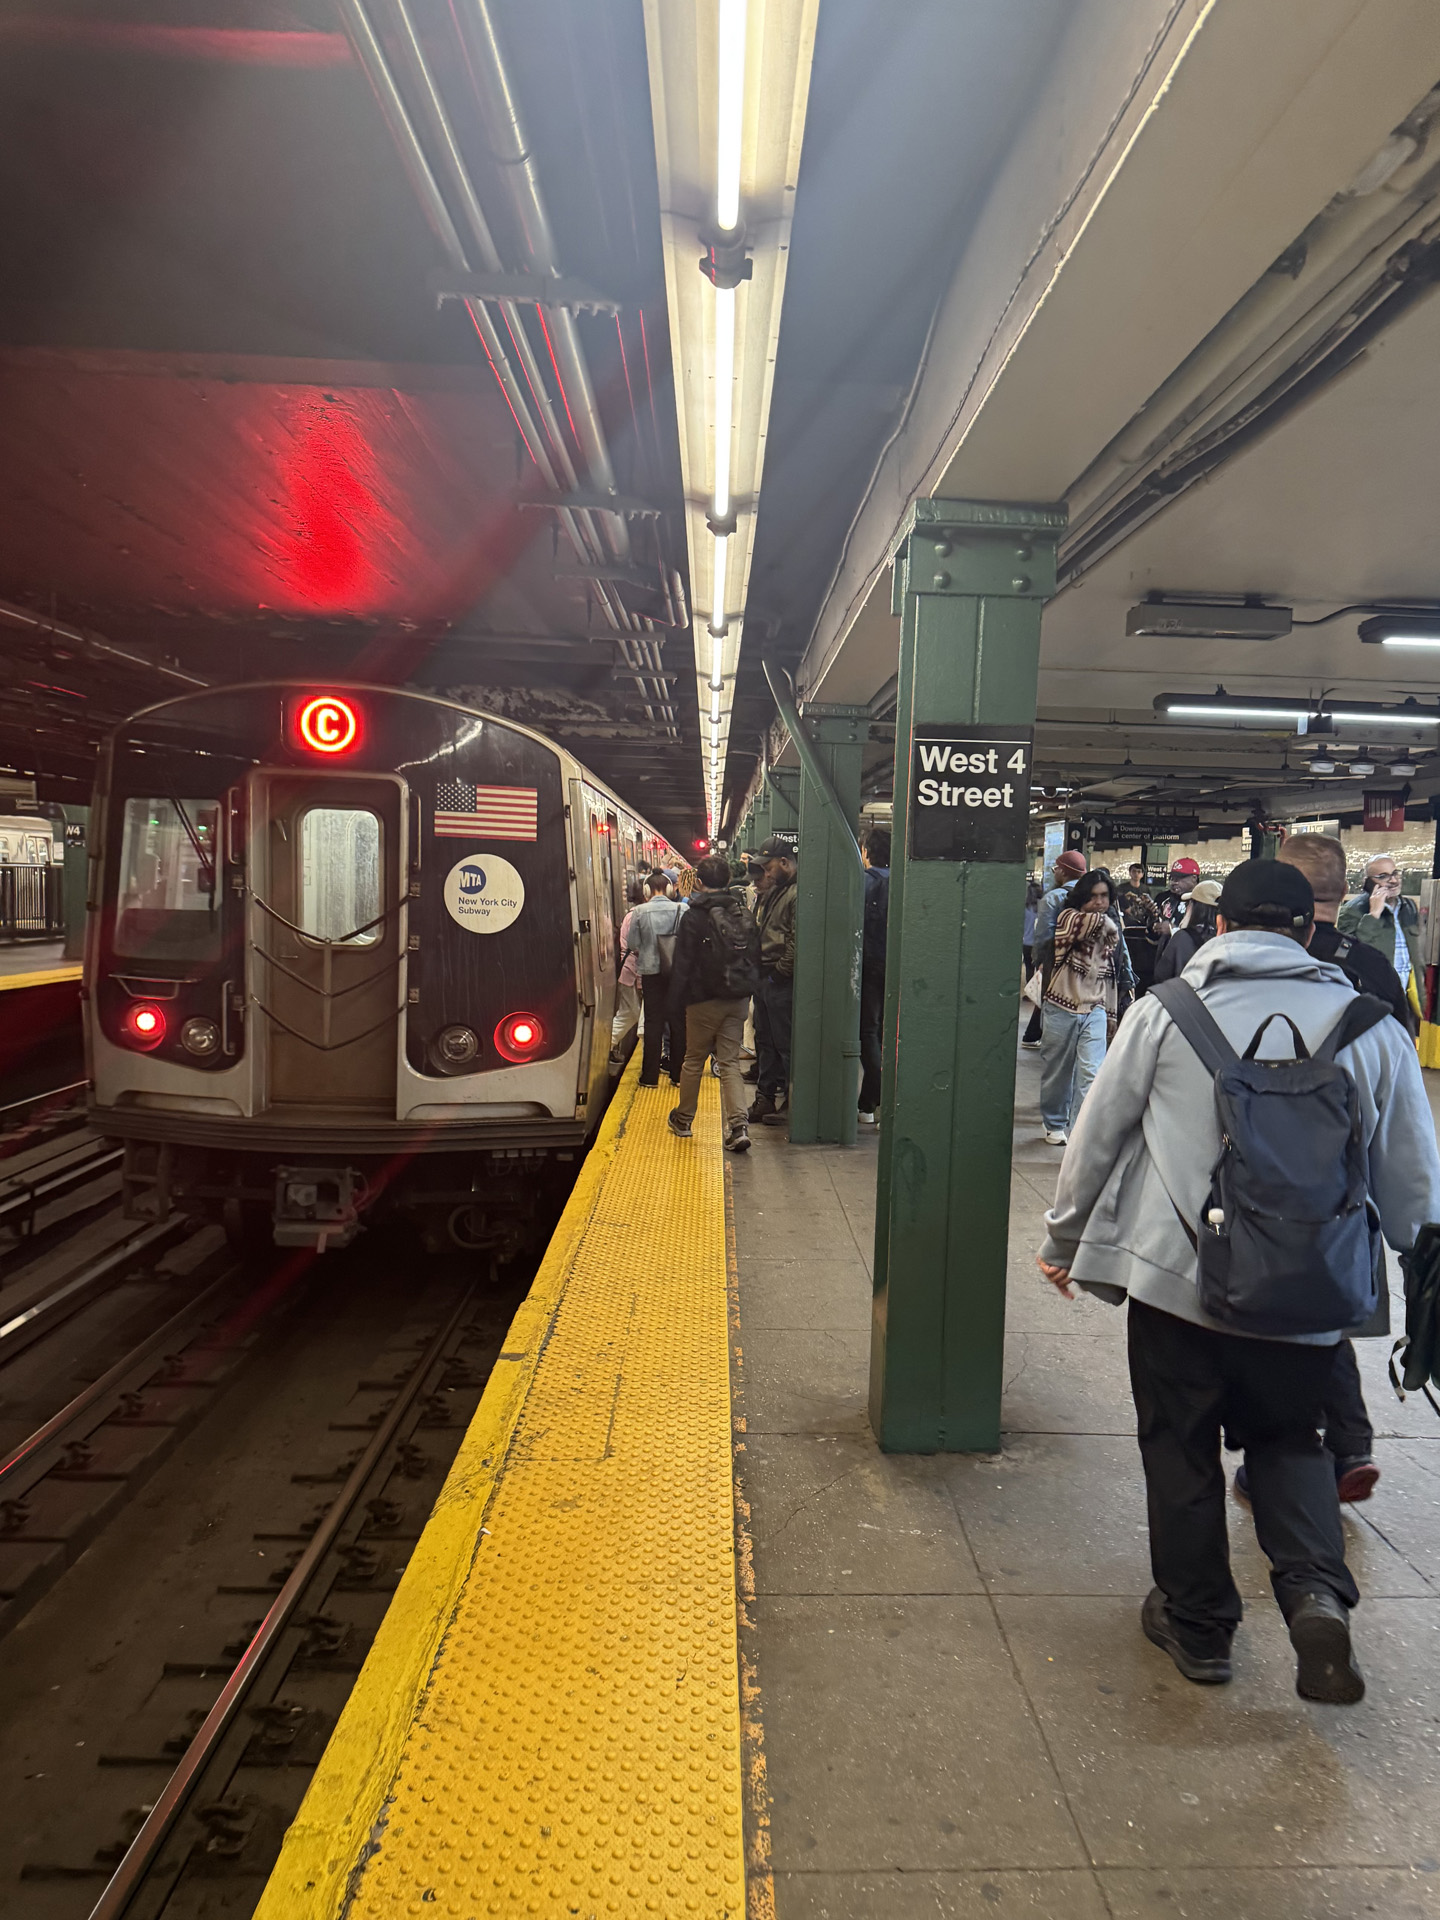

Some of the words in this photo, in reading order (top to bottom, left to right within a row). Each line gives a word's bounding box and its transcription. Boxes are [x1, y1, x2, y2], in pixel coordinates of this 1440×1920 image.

[318, 708, 339, 741] C
[919, 745, 999, 774] West
[1006, 748, 1026, 775] 4
[917, 778, 1014, 808] Street
[459, 870, 481, 888] MTA
[458, 897, 478, 905] New
[479, 897, 499, 907] York
[500, 898, 517, 908] City
[458, 906, 491, 916] Subway
